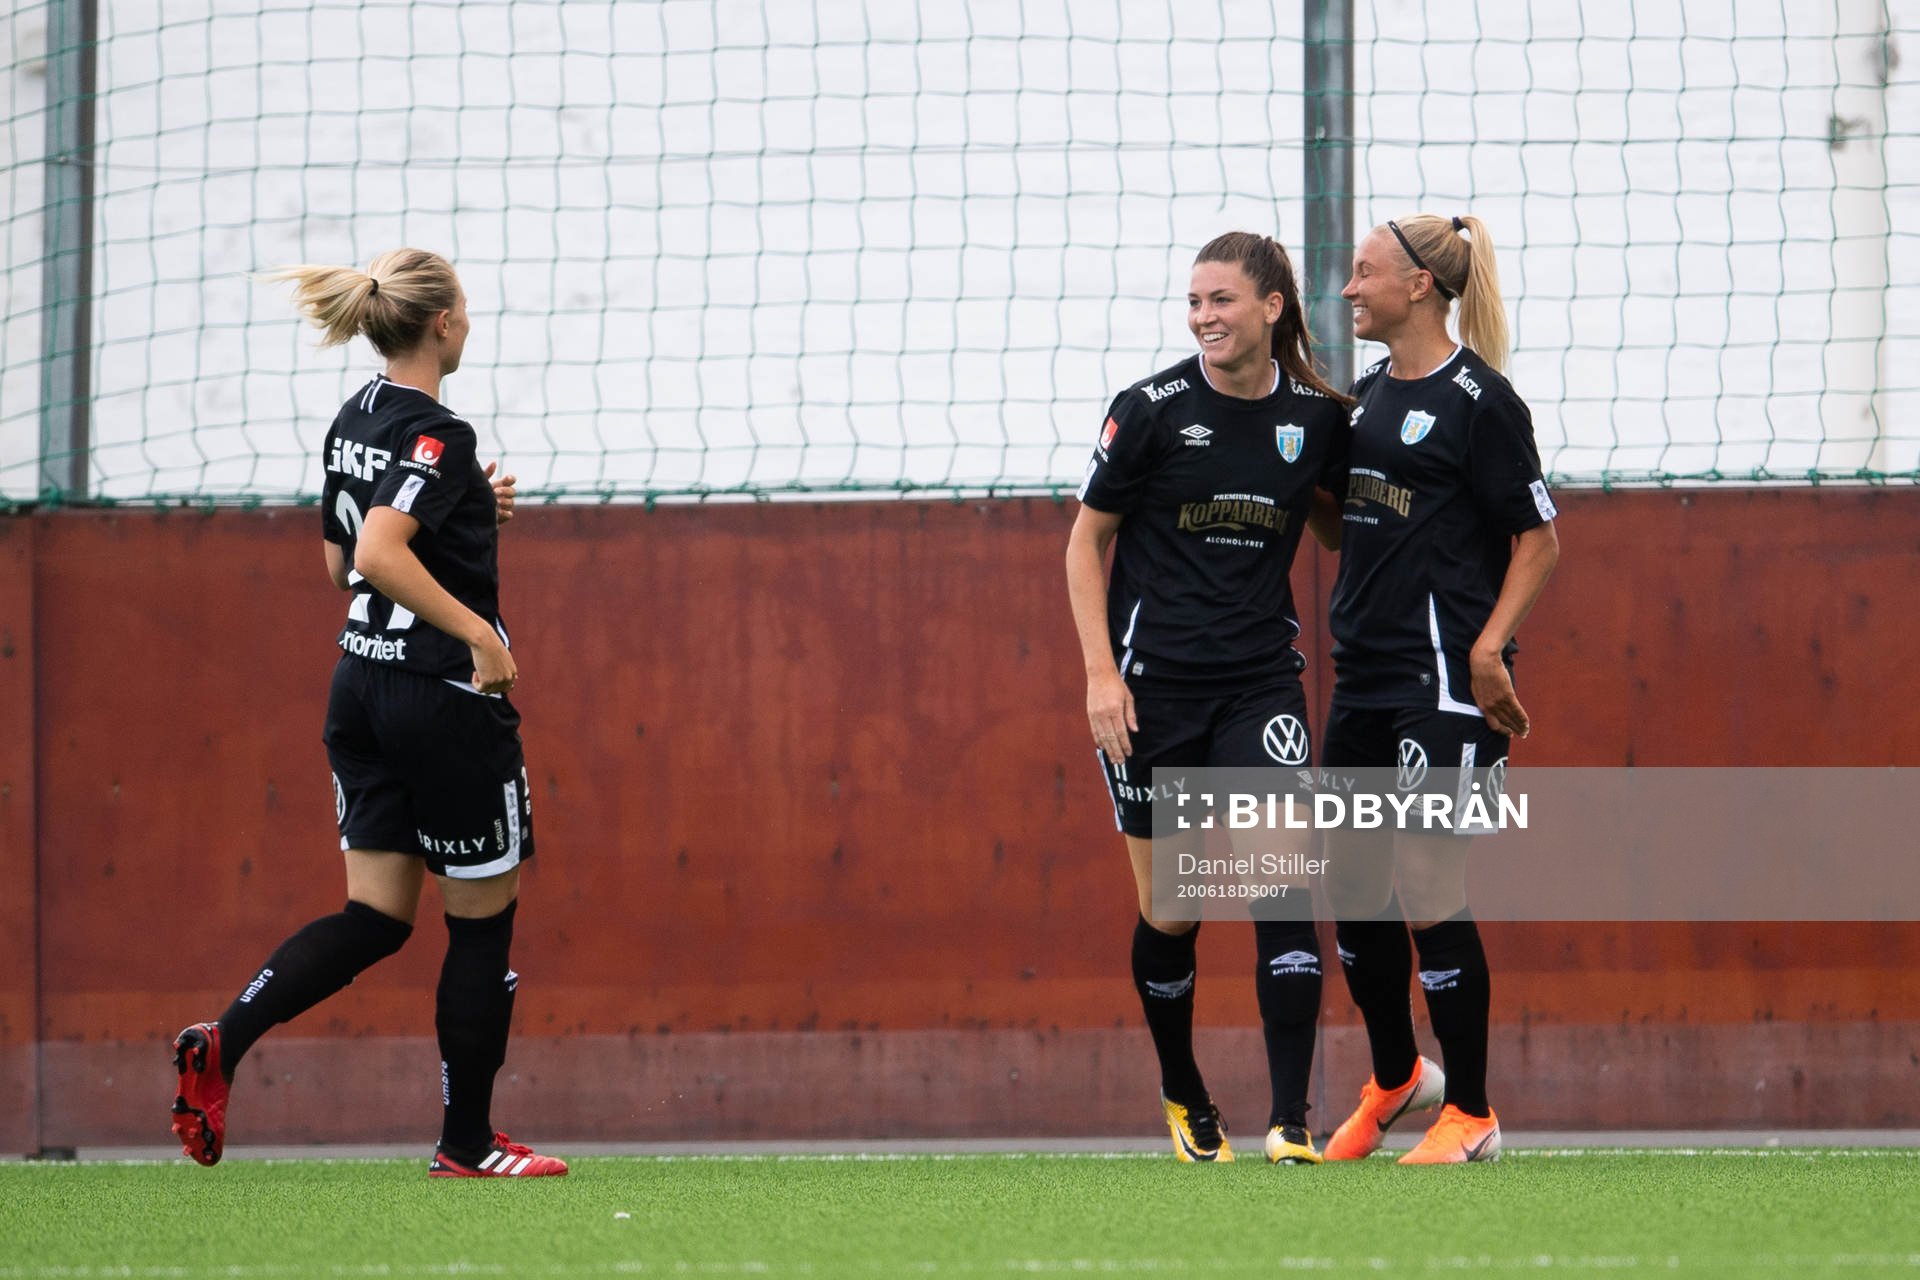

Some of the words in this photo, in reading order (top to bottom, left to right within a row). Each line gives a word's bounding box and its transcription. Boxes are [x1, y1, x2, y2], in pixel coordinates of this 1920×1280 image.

[1144, 379, 1190, 402] RASTA
[1452, 366, 1482, 400] RASTA
[1213, 493, 1251, 501] PREMIUM
[1252, 494, 1275, 506] CIDER
[1347, 475, 1412, 518] PARBERG
[1205, 536, 1265, 549] ALCOHOL-FREE
[339, 630, 406, 661] rioritet
[1117, 776, 1186, 802] BRIXLY
[494, 818, 505, 851] umbro
[240, 969, 274, 1003] umbro
[441, 1060, 450, 1106] umbro
